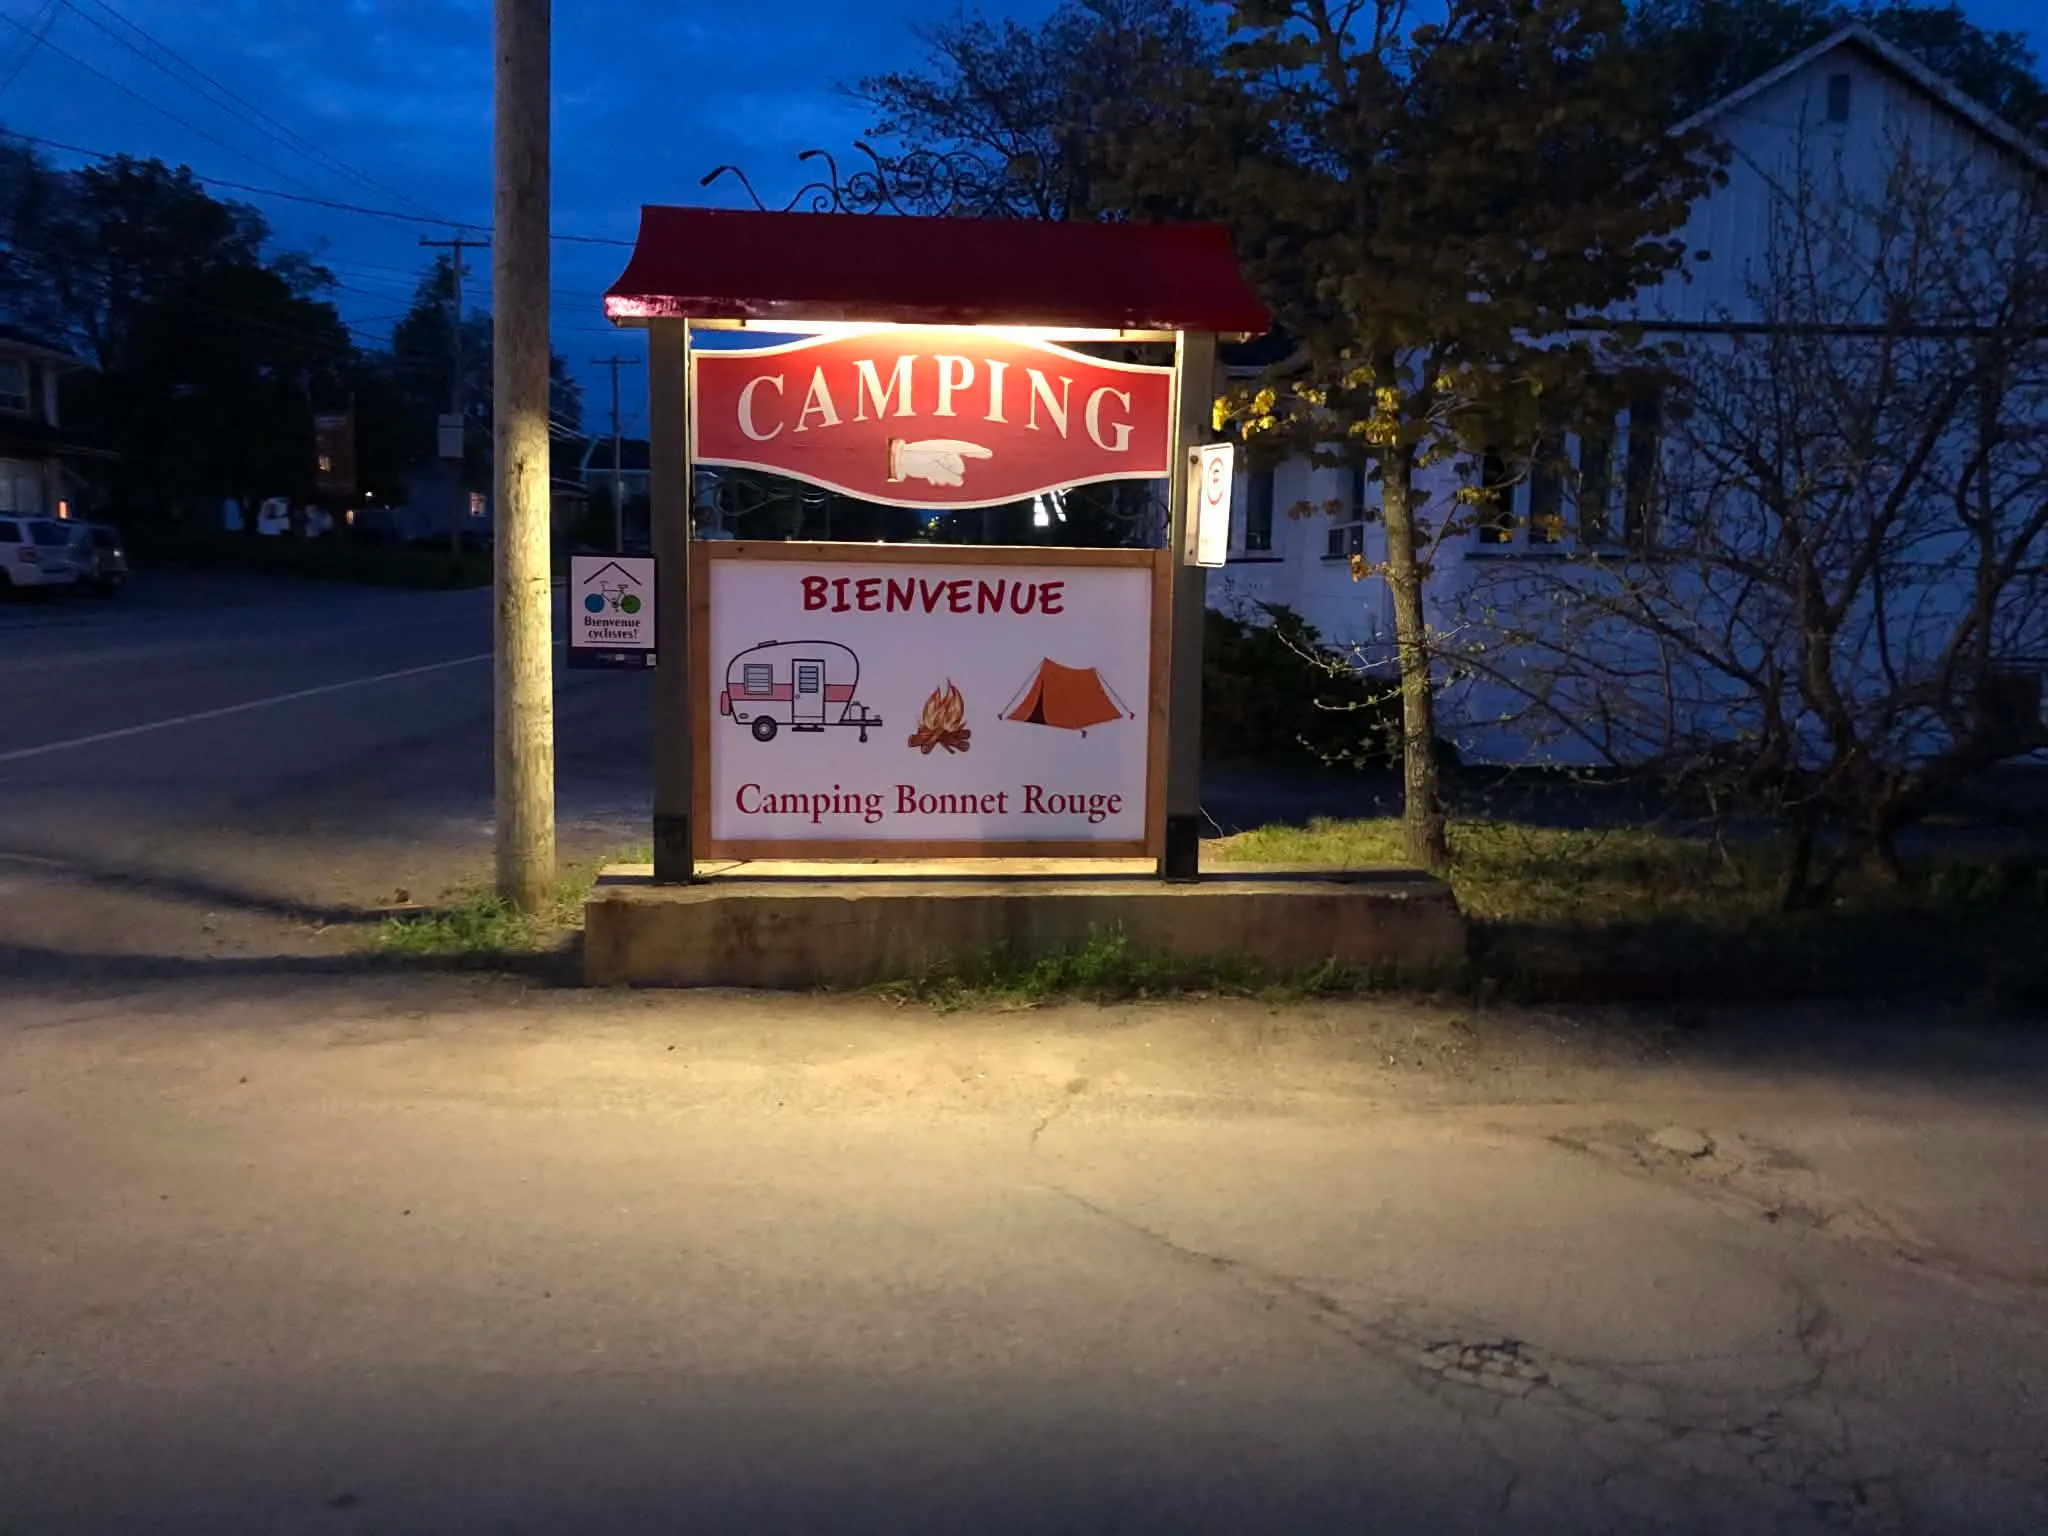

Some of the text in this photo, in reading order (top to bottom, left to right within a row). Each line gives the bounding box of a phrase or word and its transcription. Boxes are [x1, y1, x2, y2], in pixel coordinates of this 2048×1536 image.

[738, 354, 1135, 452] CAMPING
[801, 575, 1065, 615] BIENVENUE
[584, 615, 641, 628] Bienvenue
[588, 628, 638, 640] cyclistes!
[736, 783, 1122, 824] Camping Bonnet Rouge
